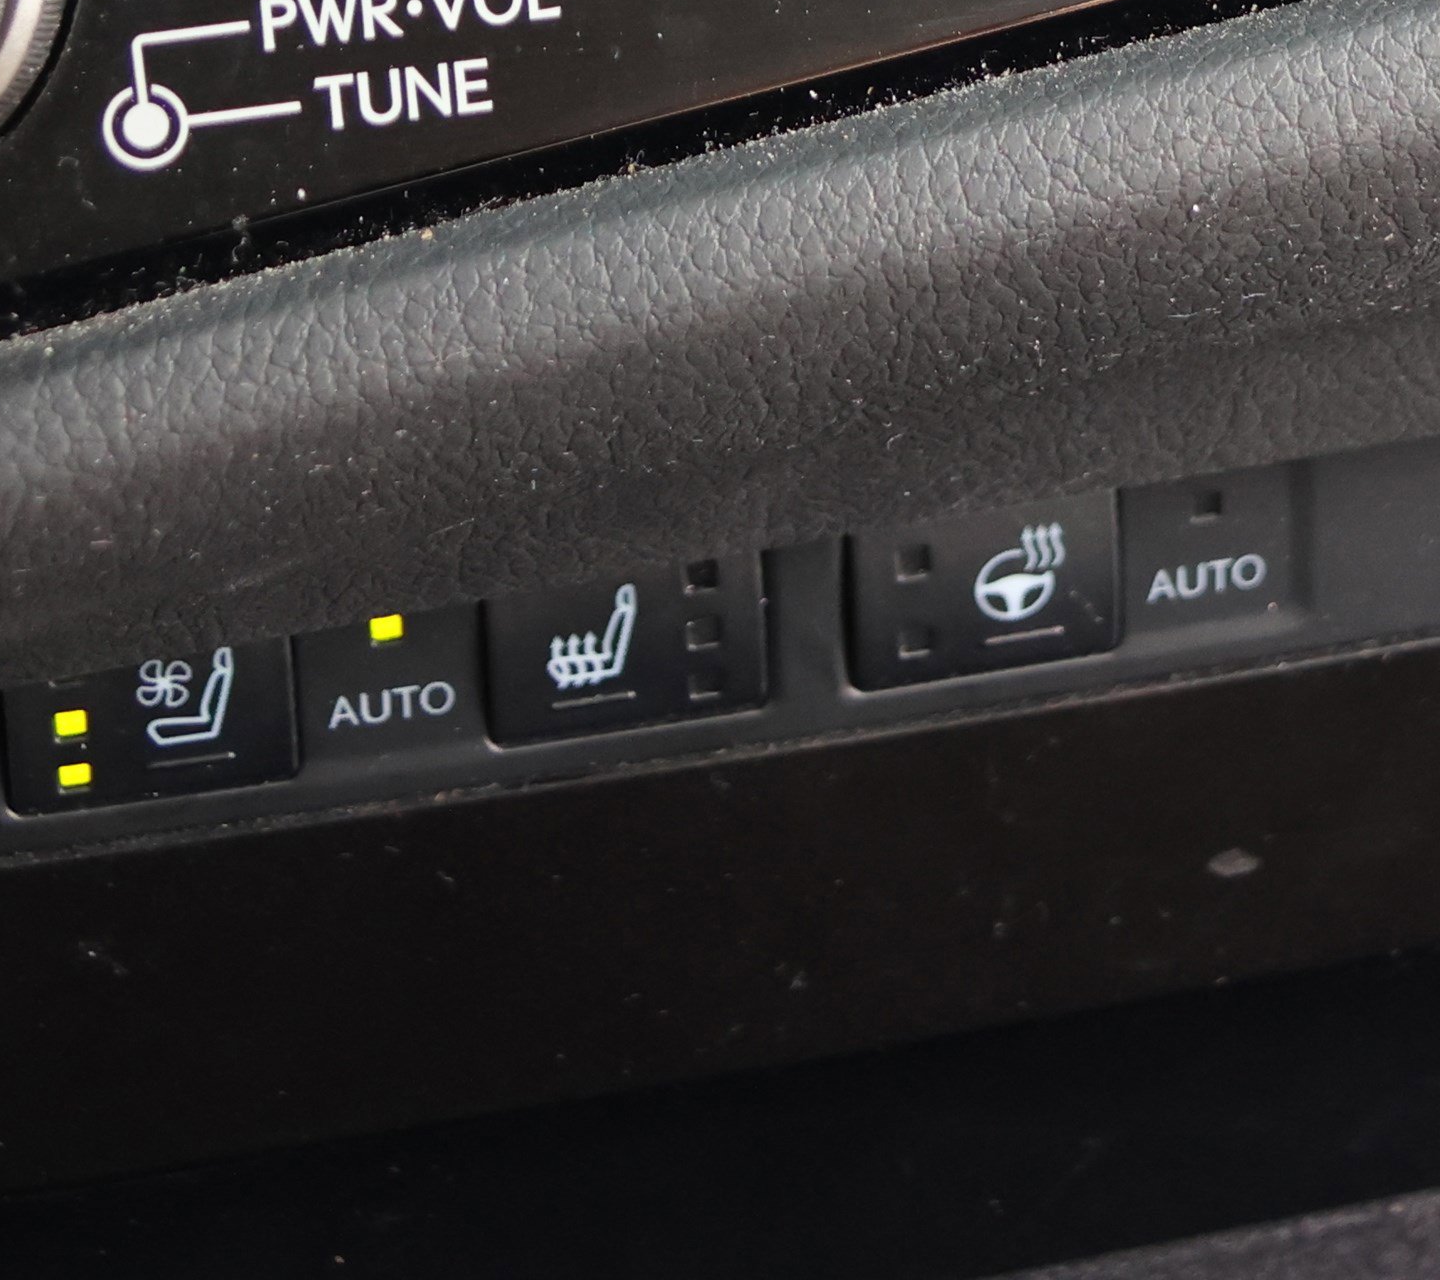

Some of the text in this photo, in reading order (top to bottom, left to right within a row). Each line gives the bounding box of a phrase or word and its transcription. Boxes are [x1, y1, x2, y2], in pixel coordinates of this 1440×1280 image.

[313, 57, 494, 130] TUNE
[1147, 554, 1265, 601] AUTO
[329, 681, 455, 729] AUTO
